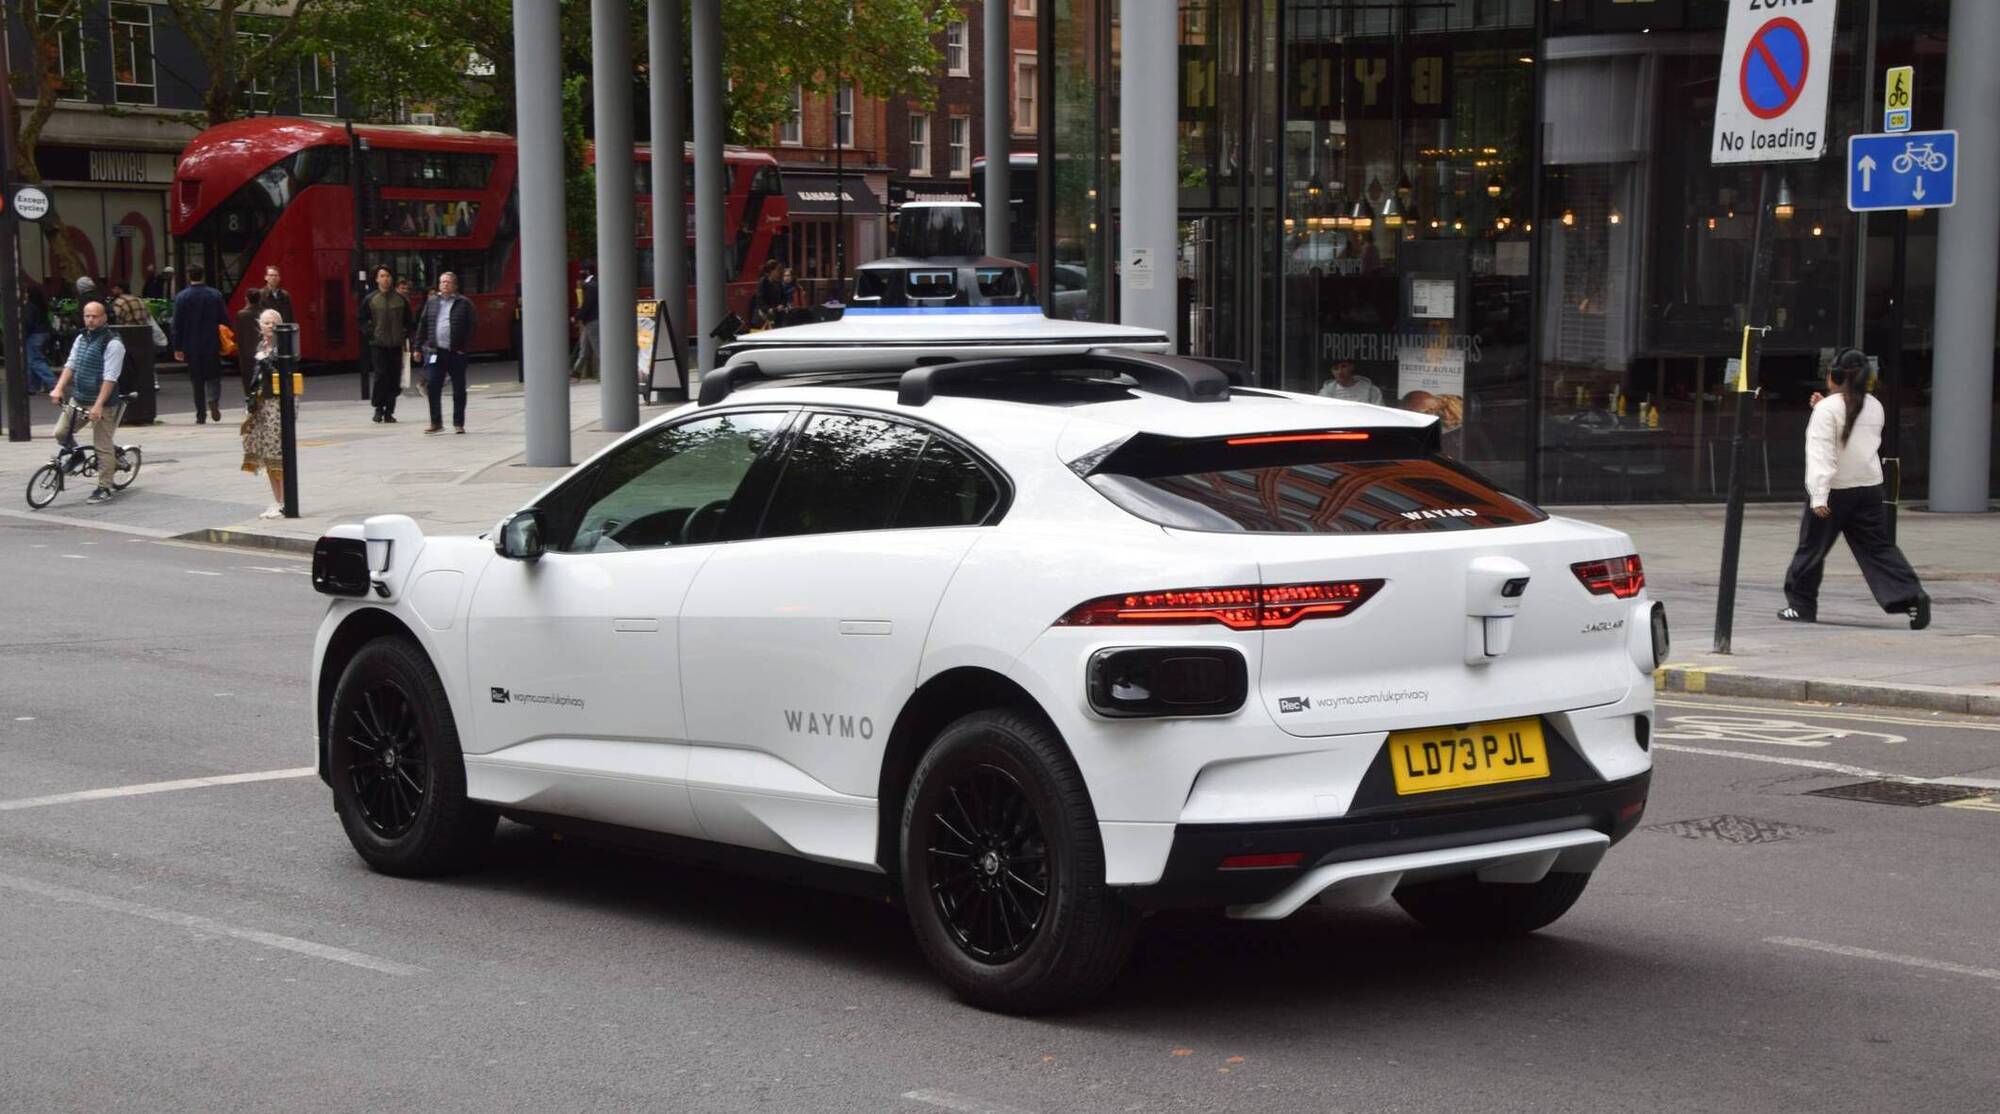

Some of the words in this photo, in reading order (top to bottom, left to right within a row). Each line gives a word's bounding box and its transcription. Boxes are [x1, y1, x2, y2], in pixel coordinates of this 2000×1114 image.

[1720, 131, 1744, 151] No
[1751, 128, 1817, 150] loading
[17, 195, 46, 205] Except
[18, 204, 45, 213] cycles
[228, 213, 239, 231] 8
[1322, 332, 1378, 361] PROPER
[1400, 507, 1478, 520] WAYMO
[1281, 701, 1300, 711] Rec
[1316, 689, 1430, 709] waymo.com/ukprivacy
[783, 709, 874, 740] WAYMO
[1403, 737, 1478, 778] LD73
[1482, 731, 1535, 769] PJL
